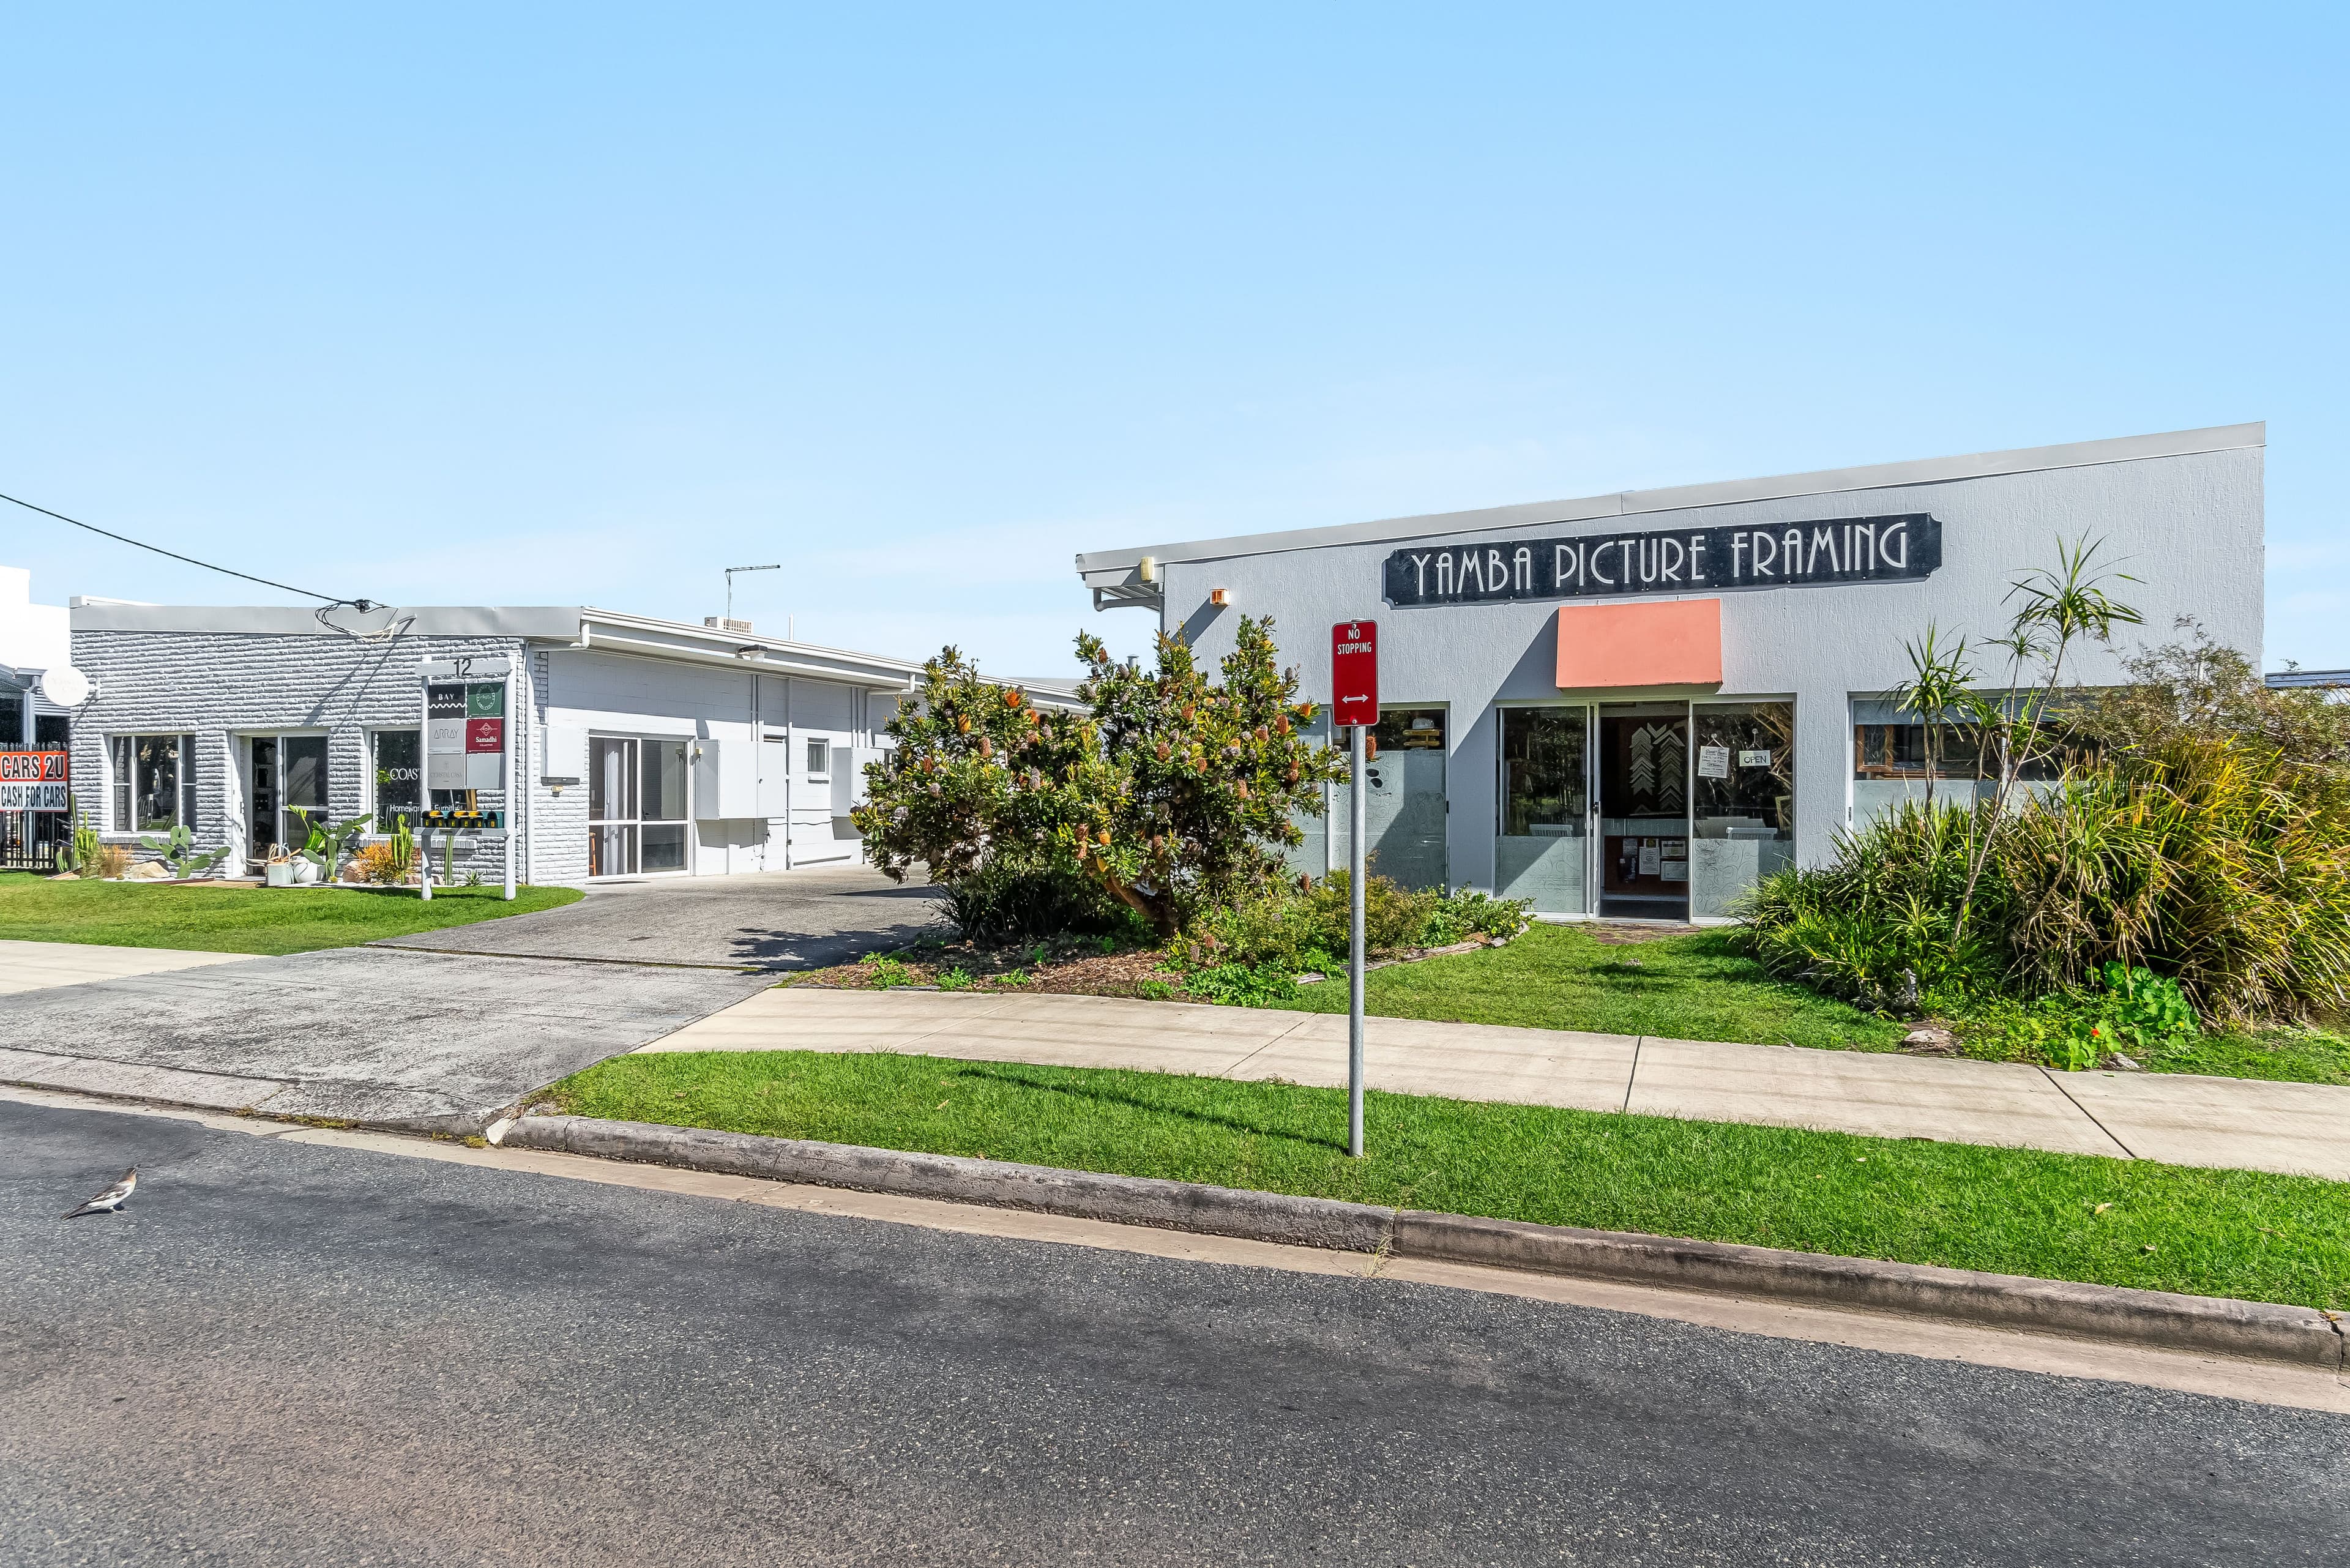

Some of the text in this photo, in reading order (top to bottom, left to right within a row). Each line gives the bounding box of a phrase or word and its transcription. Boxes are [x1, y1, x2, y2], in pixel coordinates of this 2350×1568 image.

[1411, 522, 1907, 596] YAMBA PICTURE FRAMING
[1348, 629, 1360, 640] NO
[1337, 642, 1371, 655] STOPPING
[453, 659, 472, 676] 12
[433, 728, 460, 739] ARRAY
[1, 755, 65, 780] CARS 2U
[1, 786, 66, 807] CASH FOR CARS
